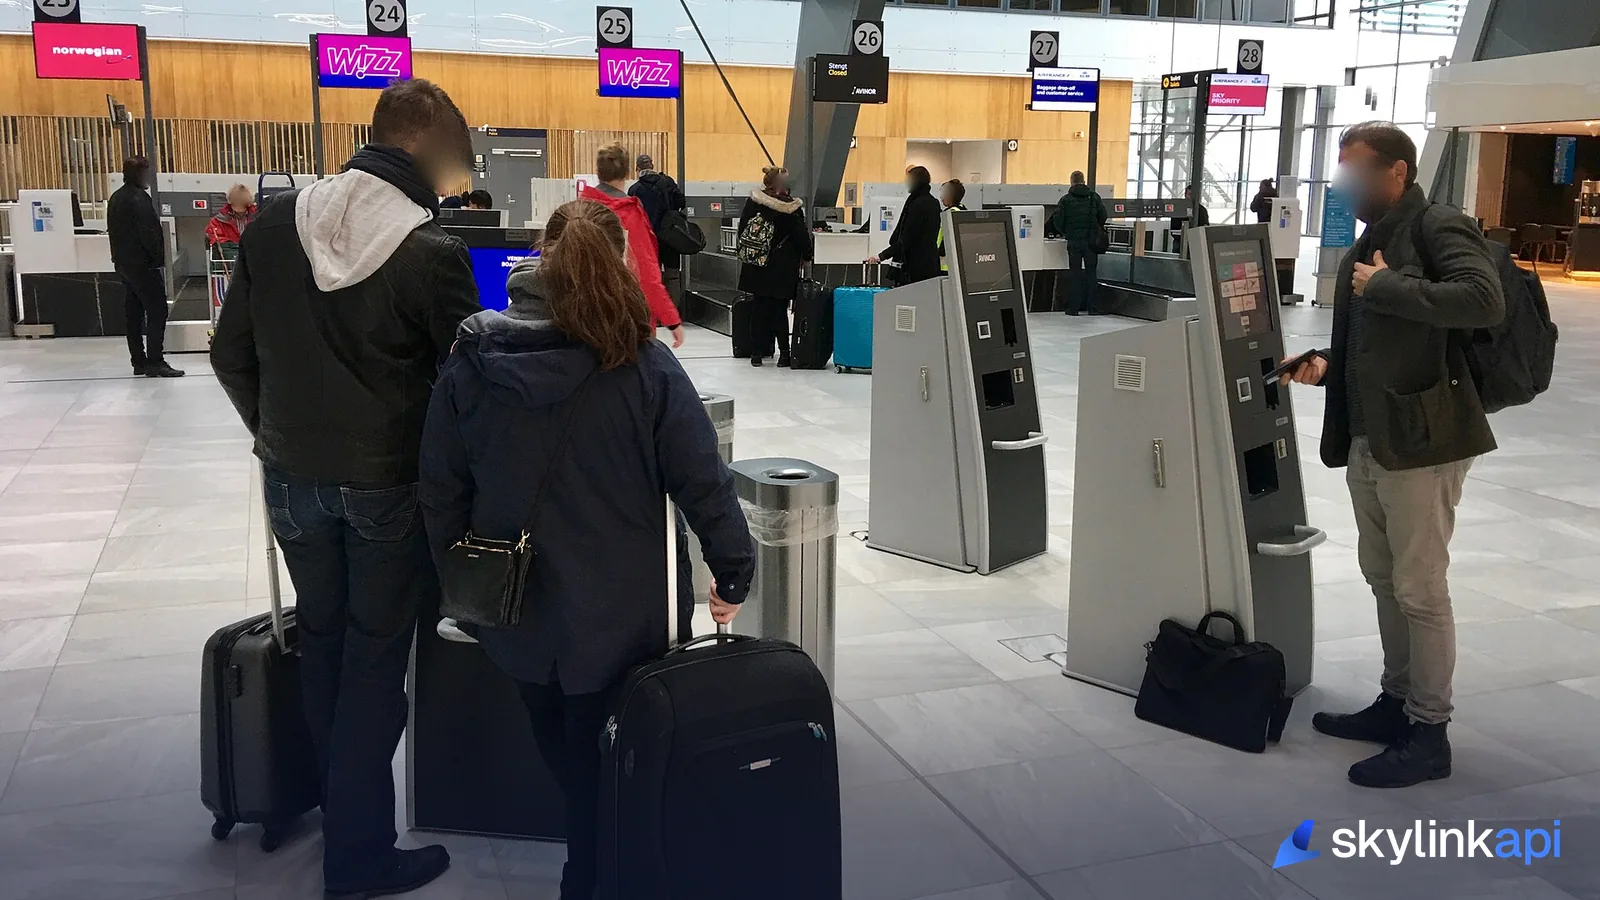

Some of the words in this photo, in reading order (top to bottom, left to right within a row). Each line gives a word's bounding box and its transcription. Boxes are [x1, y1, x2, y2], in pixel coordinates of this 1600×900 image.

[374, 4, 400, 23] 24
[603, 17, 626, 35] 25
[858, 30, 878, 47] 26
[52, 46, 122, 58] norwegian
[1036, 40, 1054, 55] 27
[1242, 48, 1259, 63] 28
[828, 62, 848, 70] Stengt
